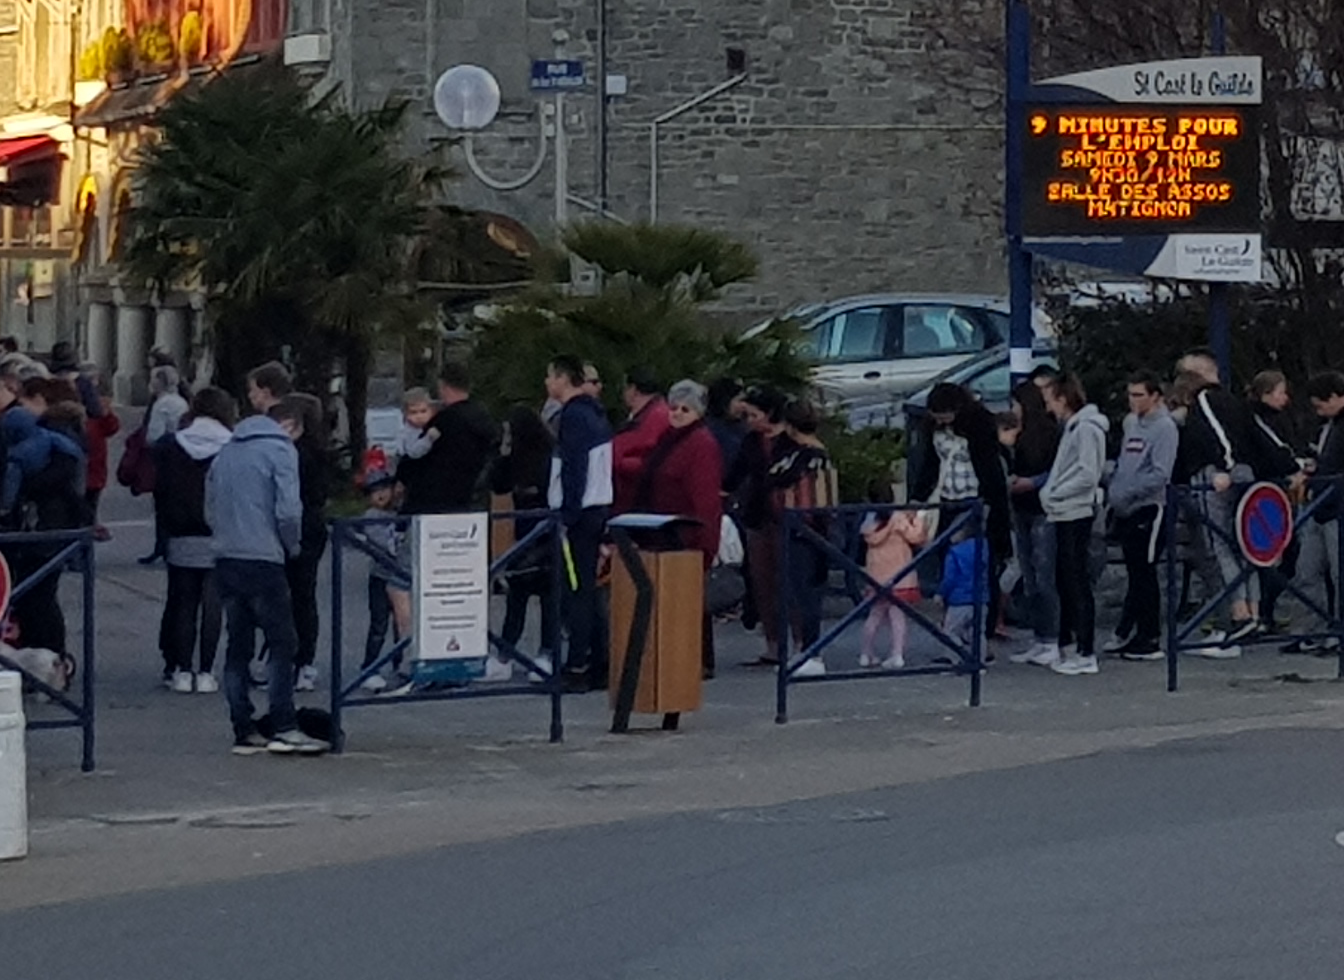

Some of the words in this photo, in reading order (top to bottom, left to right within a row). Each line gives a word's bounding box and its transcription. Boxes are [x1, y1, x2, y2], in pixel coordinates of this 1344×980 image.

[1134, 71, 1150, 96] St
[1155, 70, 1186, 96] Cast
[1032, 116, 1047, 134] 9
[1059, 117, 1166, 134] MINUTES
[1179, 118, 1238, 135] POUR
[1082, 134, 1200, 150] L'EMPLOI
[1061, 151, 1136, 167] SAMEDI
[1146, 151, 1159, 167] 9
[1168, 151, 1221, 168] MARS
[1048, 184, 1111, 200] SALLE
[1121, 184, 1159, 199] DES
[1168, 184, 1230, 200] ASSOS
[1088, 200, 1191, 217] MATIGNON
